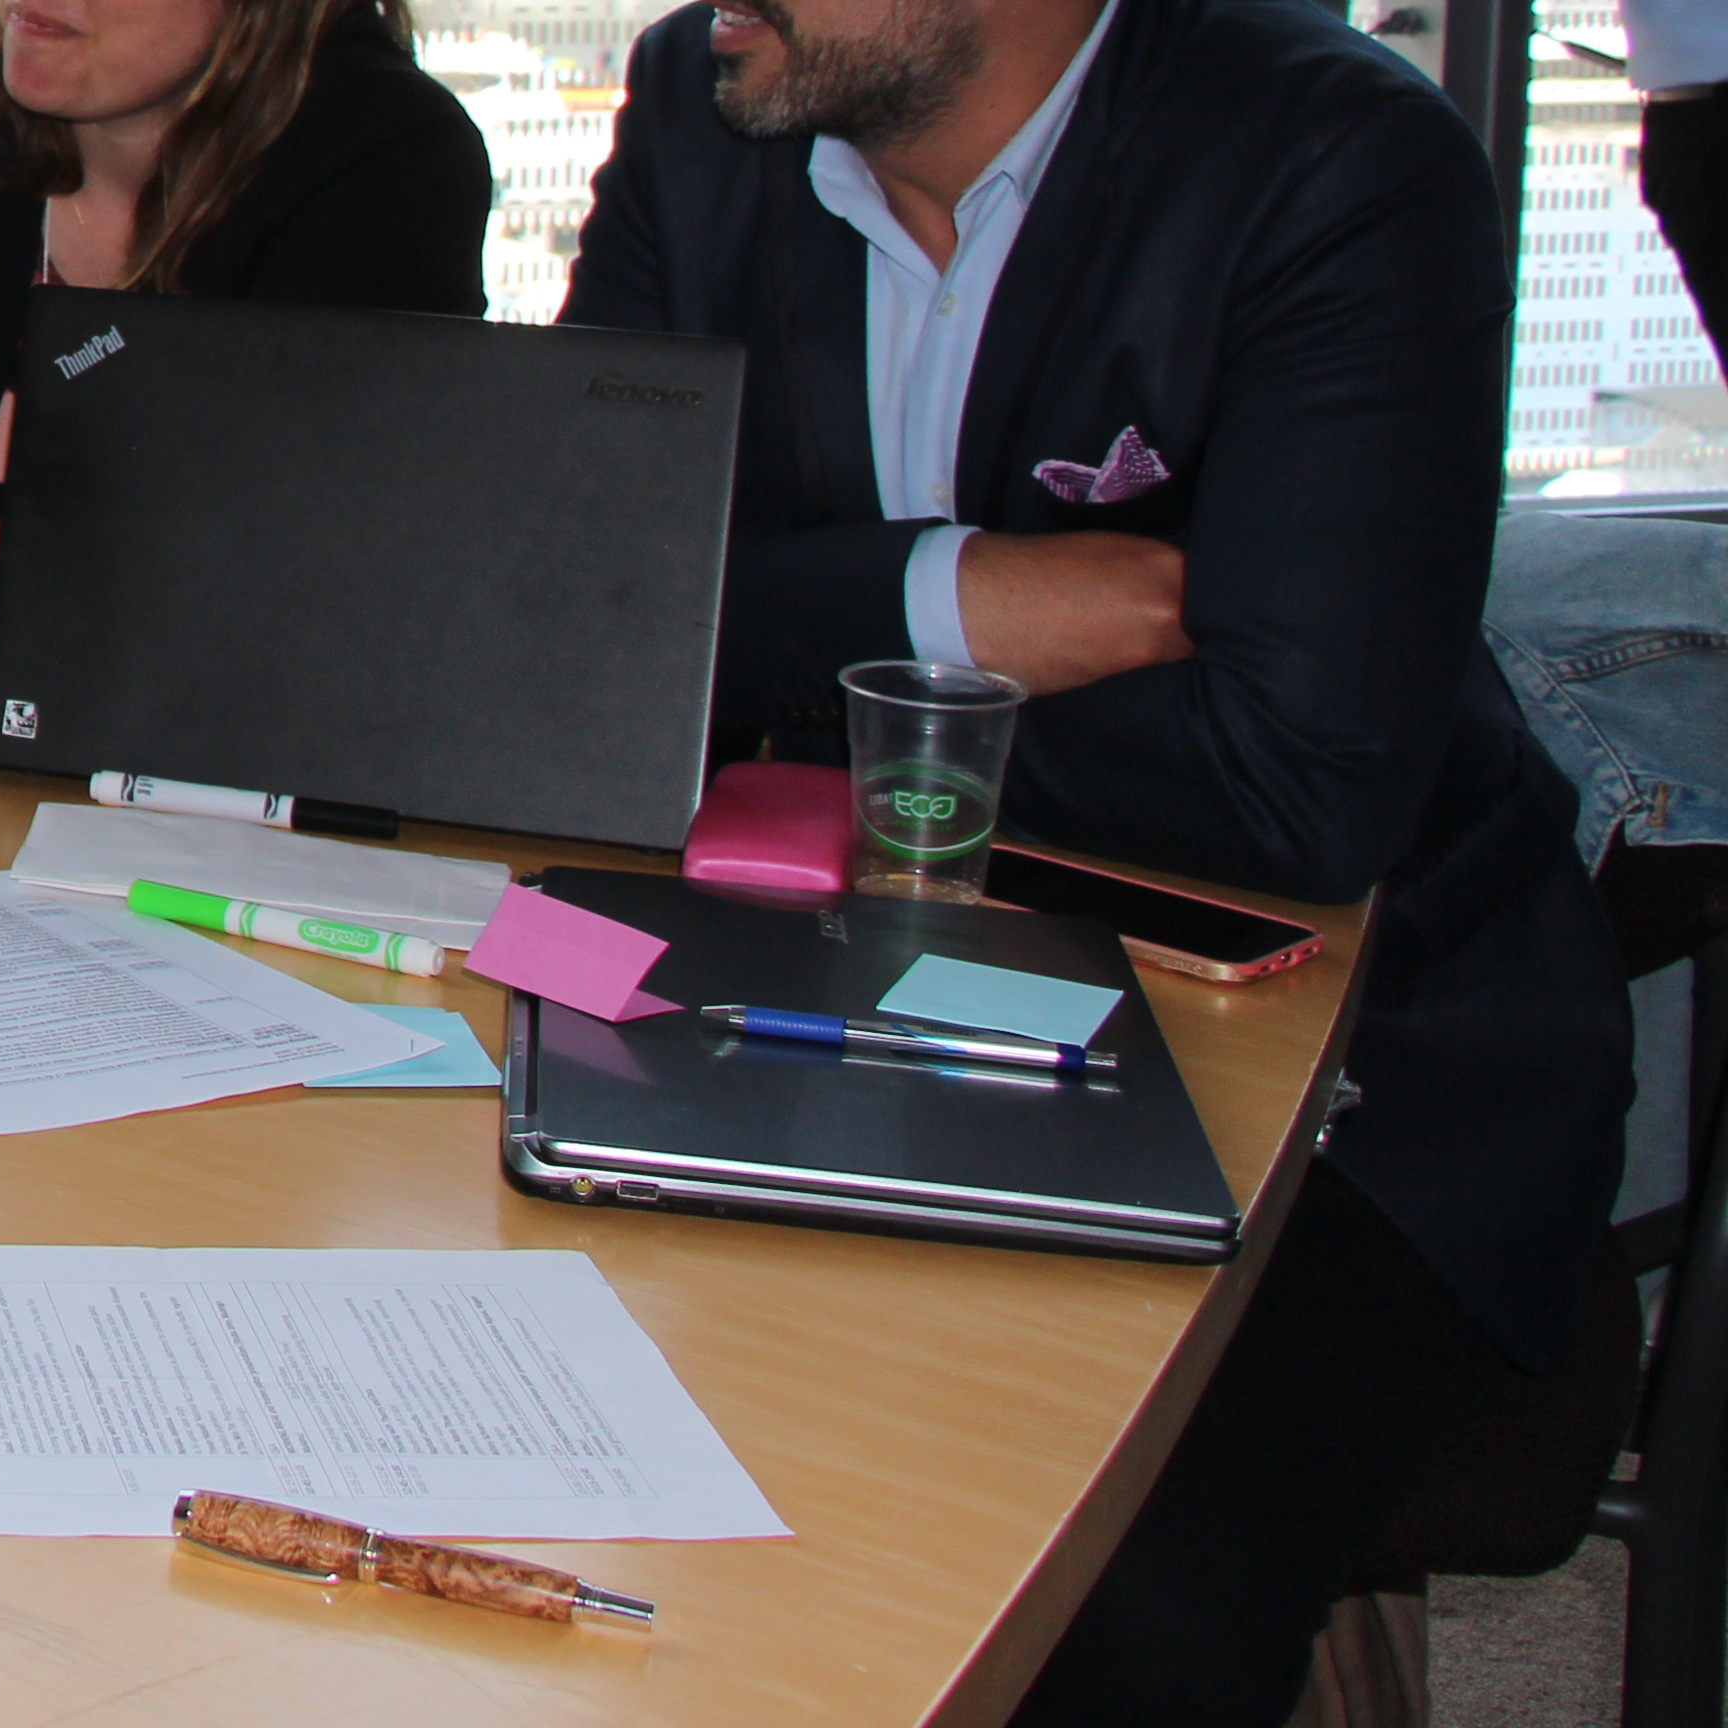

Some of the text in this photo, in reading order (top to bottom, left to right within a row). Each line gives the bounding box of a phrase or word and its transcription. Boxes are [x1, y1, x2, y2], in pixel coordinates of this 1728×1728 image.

[54, 325, 125, 380] ThinkPad
[895, 791, 957, 819] ECO
[304, 922, 372, 948] Crayola
